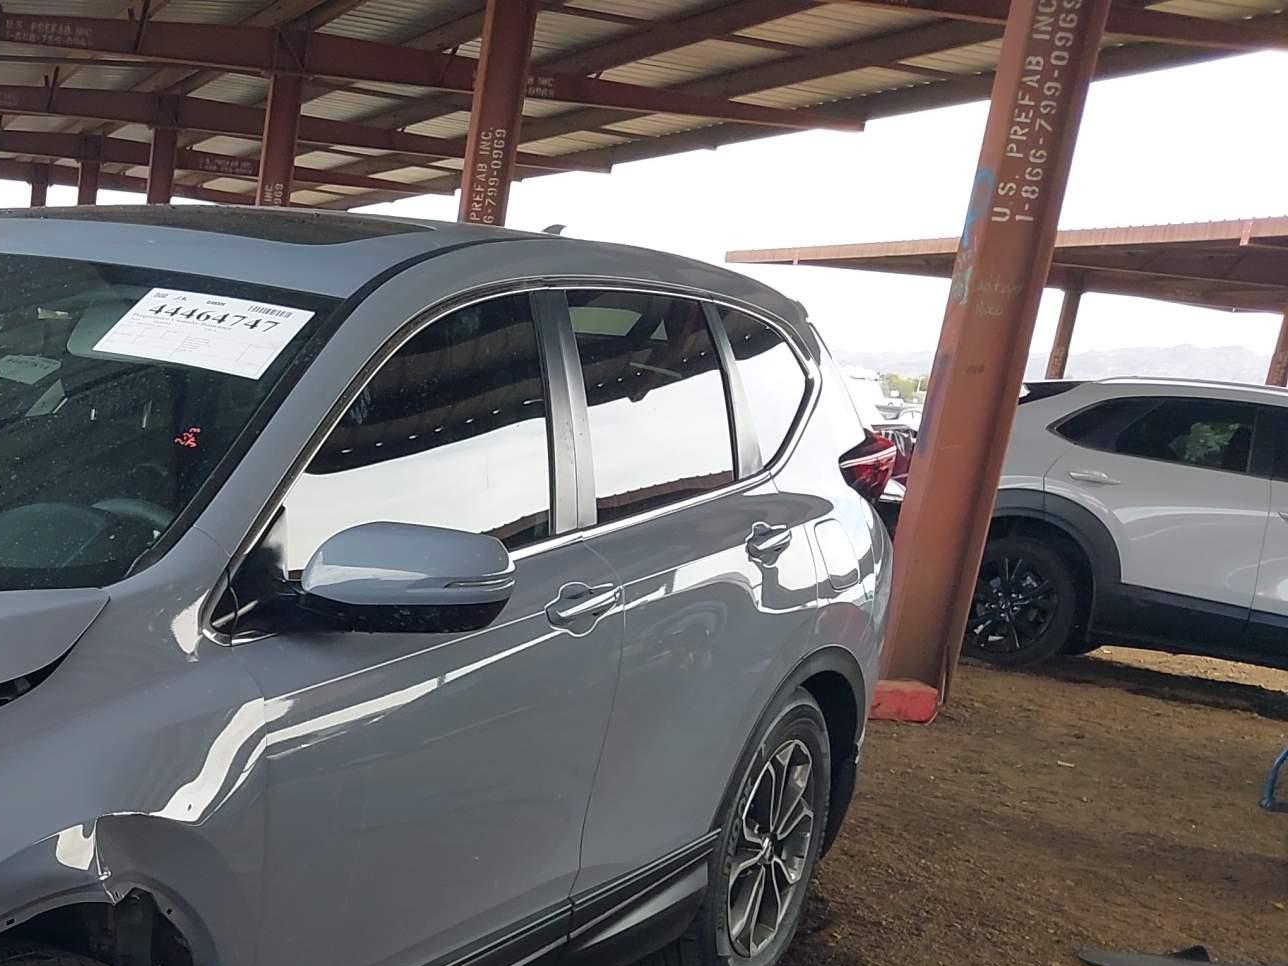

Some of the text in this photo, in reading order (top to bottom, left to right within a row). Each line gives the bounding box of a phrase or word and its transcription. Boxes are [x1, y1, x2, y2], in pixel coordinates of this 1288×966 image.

[1005, 55, 1044, 158] PREFAB
[469, 162, 488, 221] PREFAB
[148, 303, 281, 333] 44464747
